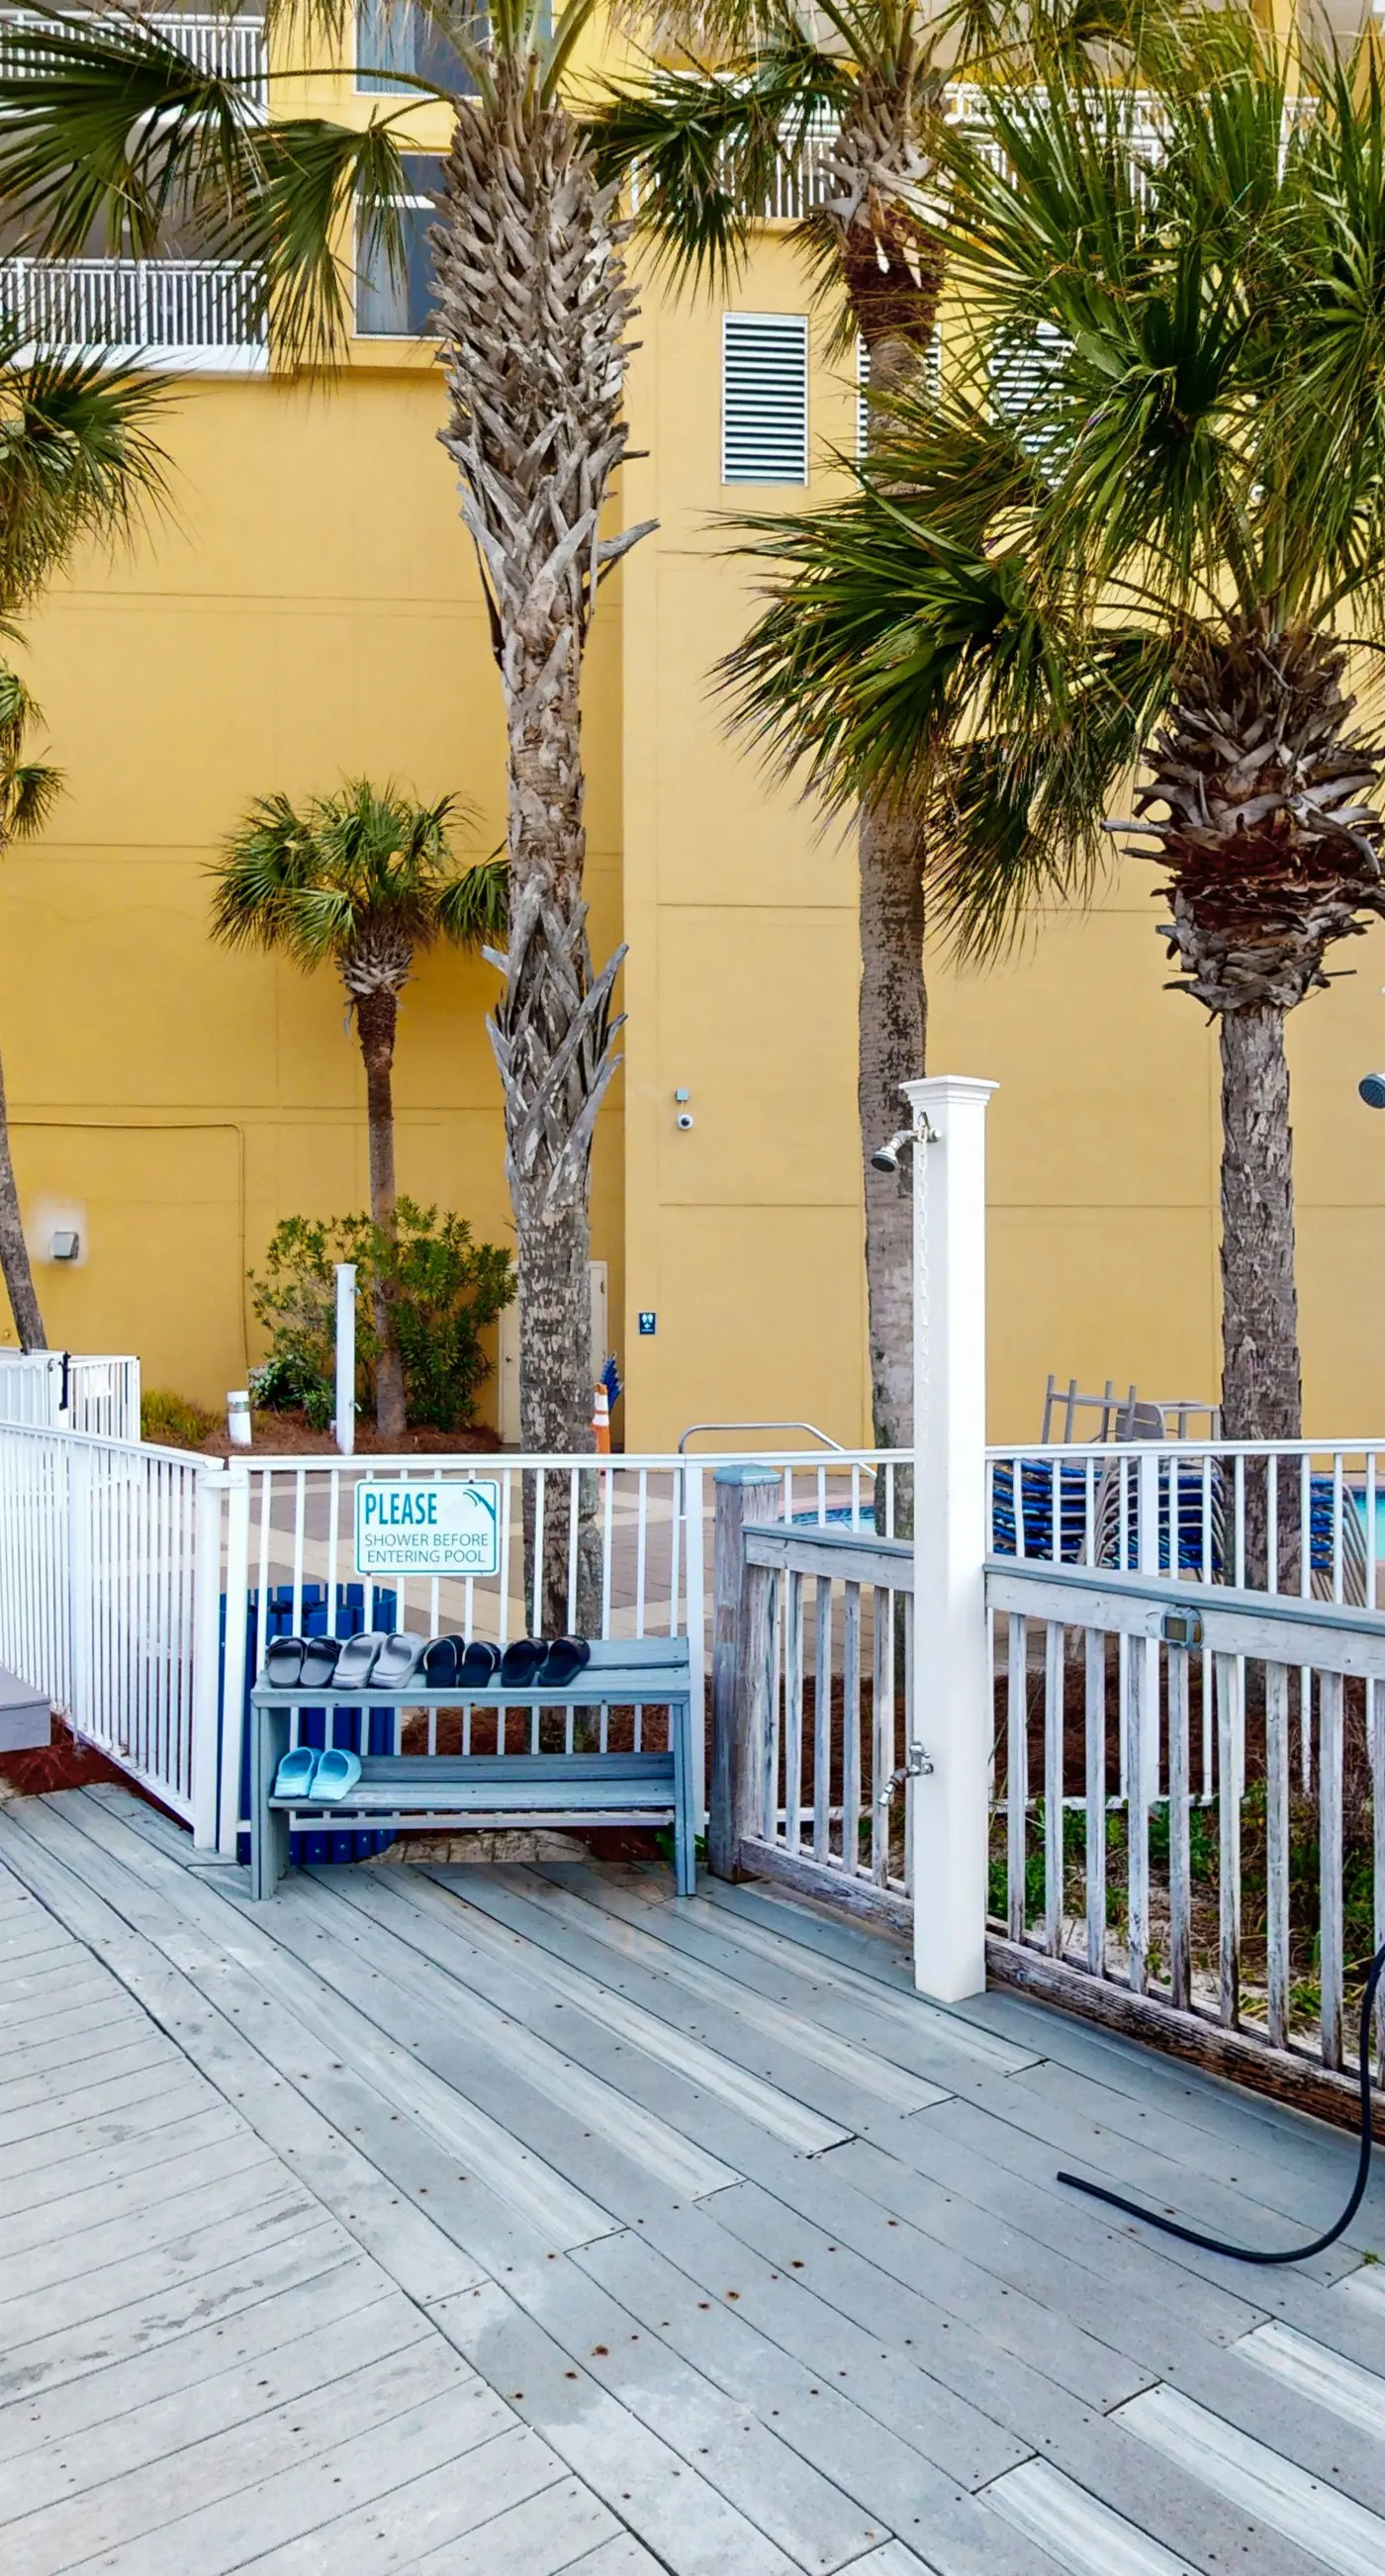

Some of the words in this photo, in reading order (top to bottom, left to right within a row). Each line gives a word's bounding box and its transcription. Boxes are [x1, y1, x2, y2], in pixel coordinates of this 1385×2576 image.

[365, 1493, 437, 1524] PLEASE
[365, 1533, 428, 1546] SHOWER
[433, 1533, 489, 1546] BEFORE
[367, 1549, 440, 1563] ENTERING
[444, 1549, 486, 1563] POOL
